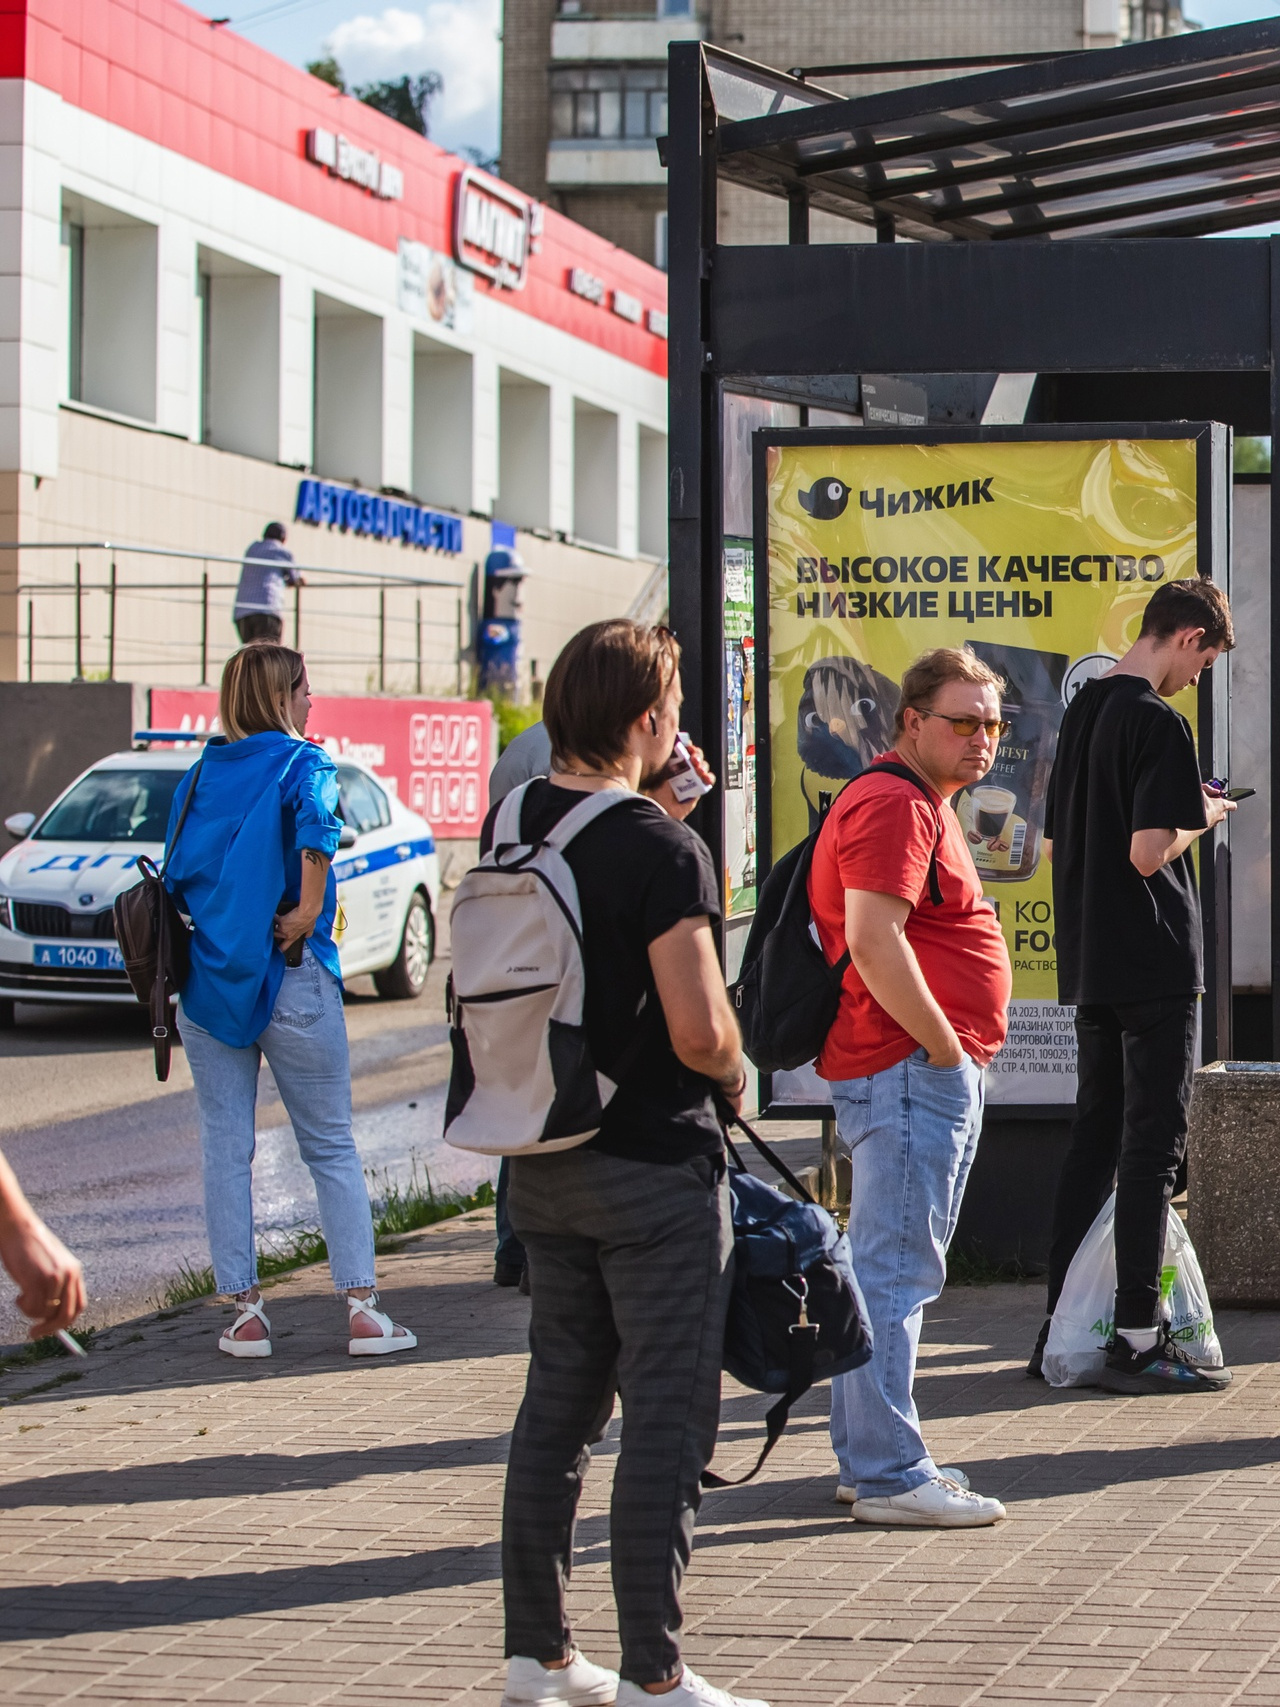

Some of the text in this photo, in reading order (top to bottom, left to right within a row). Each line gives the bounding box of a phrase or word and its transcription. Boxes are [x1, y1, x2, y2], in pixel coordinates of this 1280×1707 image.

[298, 480, 463, 554] АВТОЗАПЧАСТИ
[796, 554, 1165, 584] ВЫСОКОЕ КАЧЕСТВО
[796, 590, 1053, 624] НИЗКИЕ ЦЕНЫ
[1015, 900, 1052, 924] КО
[1015, 930, 1057, 952] FO
[41, 949, 123, 965] А 1040 76
[1014, 960, 1058, 971] РАСТВО
[1008, 1007, 1077, 1018] ТА 2023, ПОКА ТО
[1056, 1021, 1074, 1032] ТОРГ
[1010, 1033, 1051, 1046] ТОРГОВОЙ
[1054, 1035, 1074, 1046] СЕТИ
[994, 1049, 1037, 1061] 345164751,
[1039, 1049, 1070, 1061] 109029,
[1002, 1062, 1019, 1073] СТР.
[1020, 1062, 1027, 1074] 4,
[1029, 1062, 1050, 1073] ПОМ.
[1065, 1063, 1077, 1074] КО
